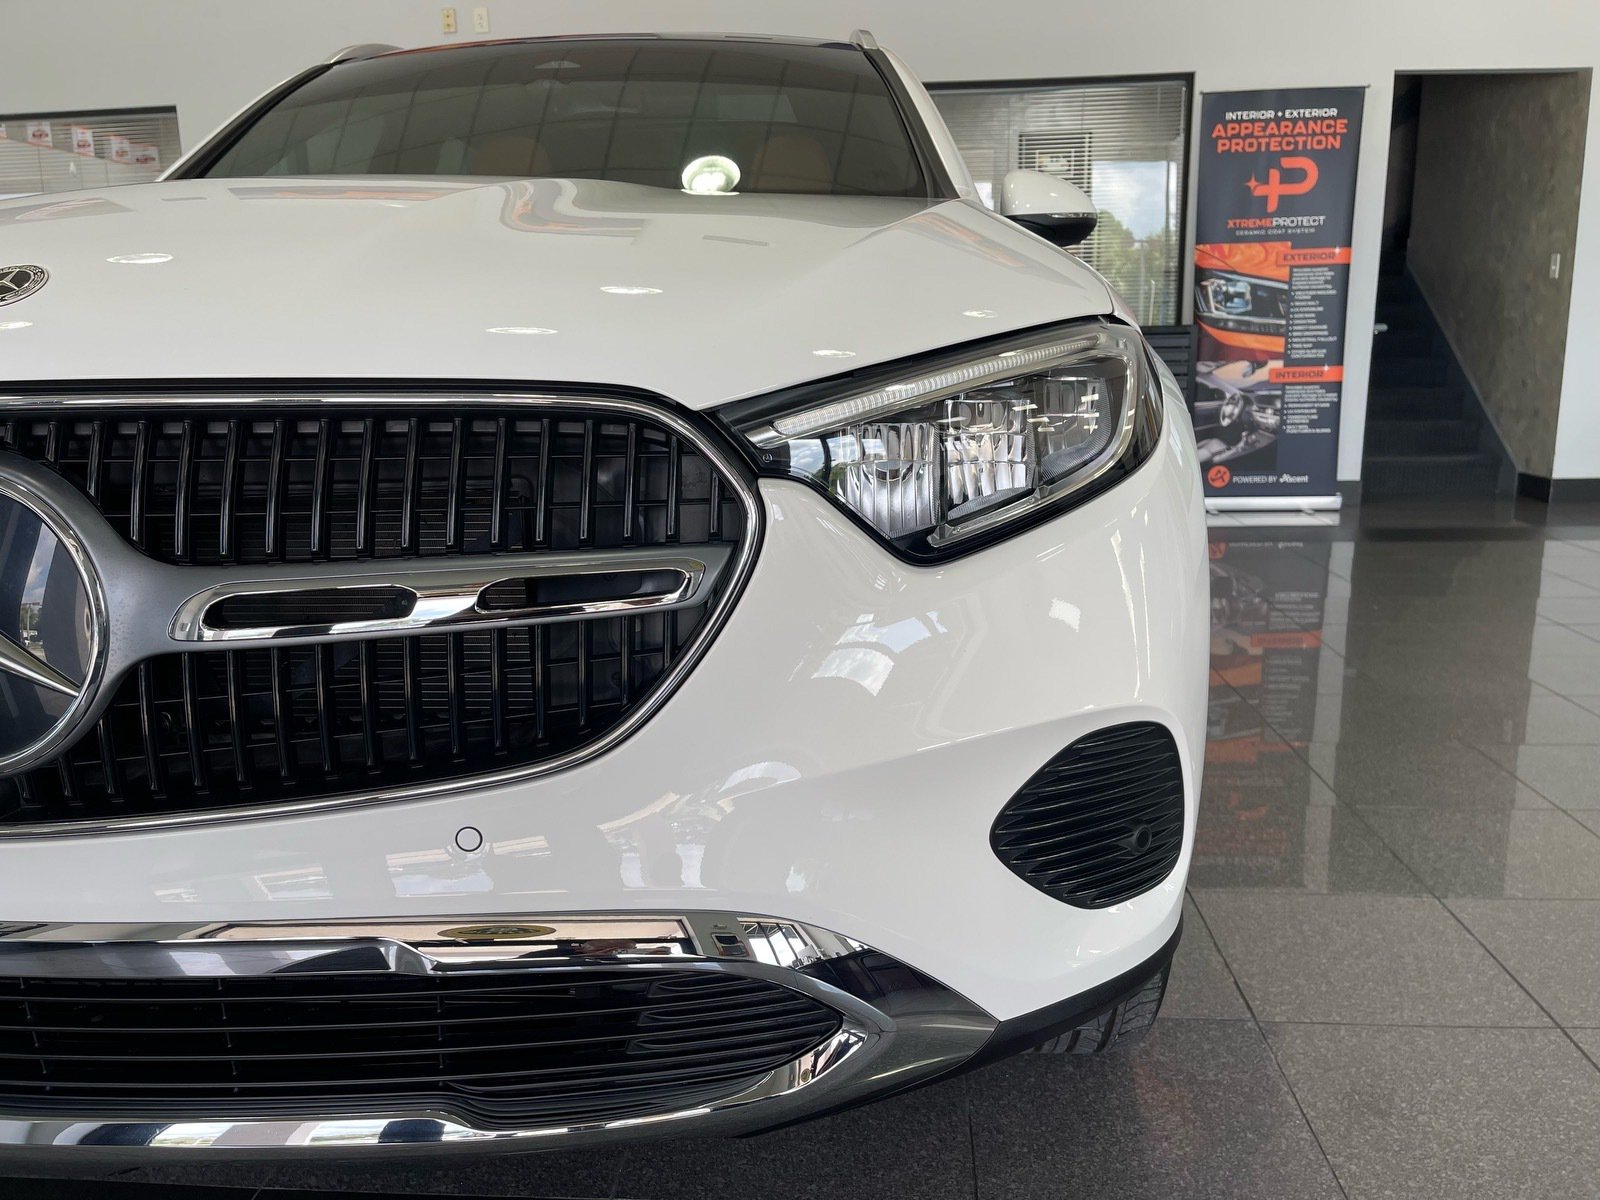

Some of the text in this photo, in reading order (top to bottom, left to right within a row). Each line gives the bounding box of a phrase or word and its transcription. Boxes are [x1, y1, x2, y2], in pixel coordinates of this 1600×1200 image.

[1225, 109, 1275, 120] INTERIOR
[1284, 108, 1338, 119] EXTERIOR
[1211, 119, 1348, 138] APPEARANCE
[1216, 135, 1341, 153] PROTECTION
[1227, 215, 1326, 228] XTREMEPROTECT
[1283, 252, 1336, 262] EXTERIOR
[1275, 370, 1324, 379] INTERIOR
[1232, 475, 1267, 484] POWERED
[1268, 475, 1278, 483] BY
